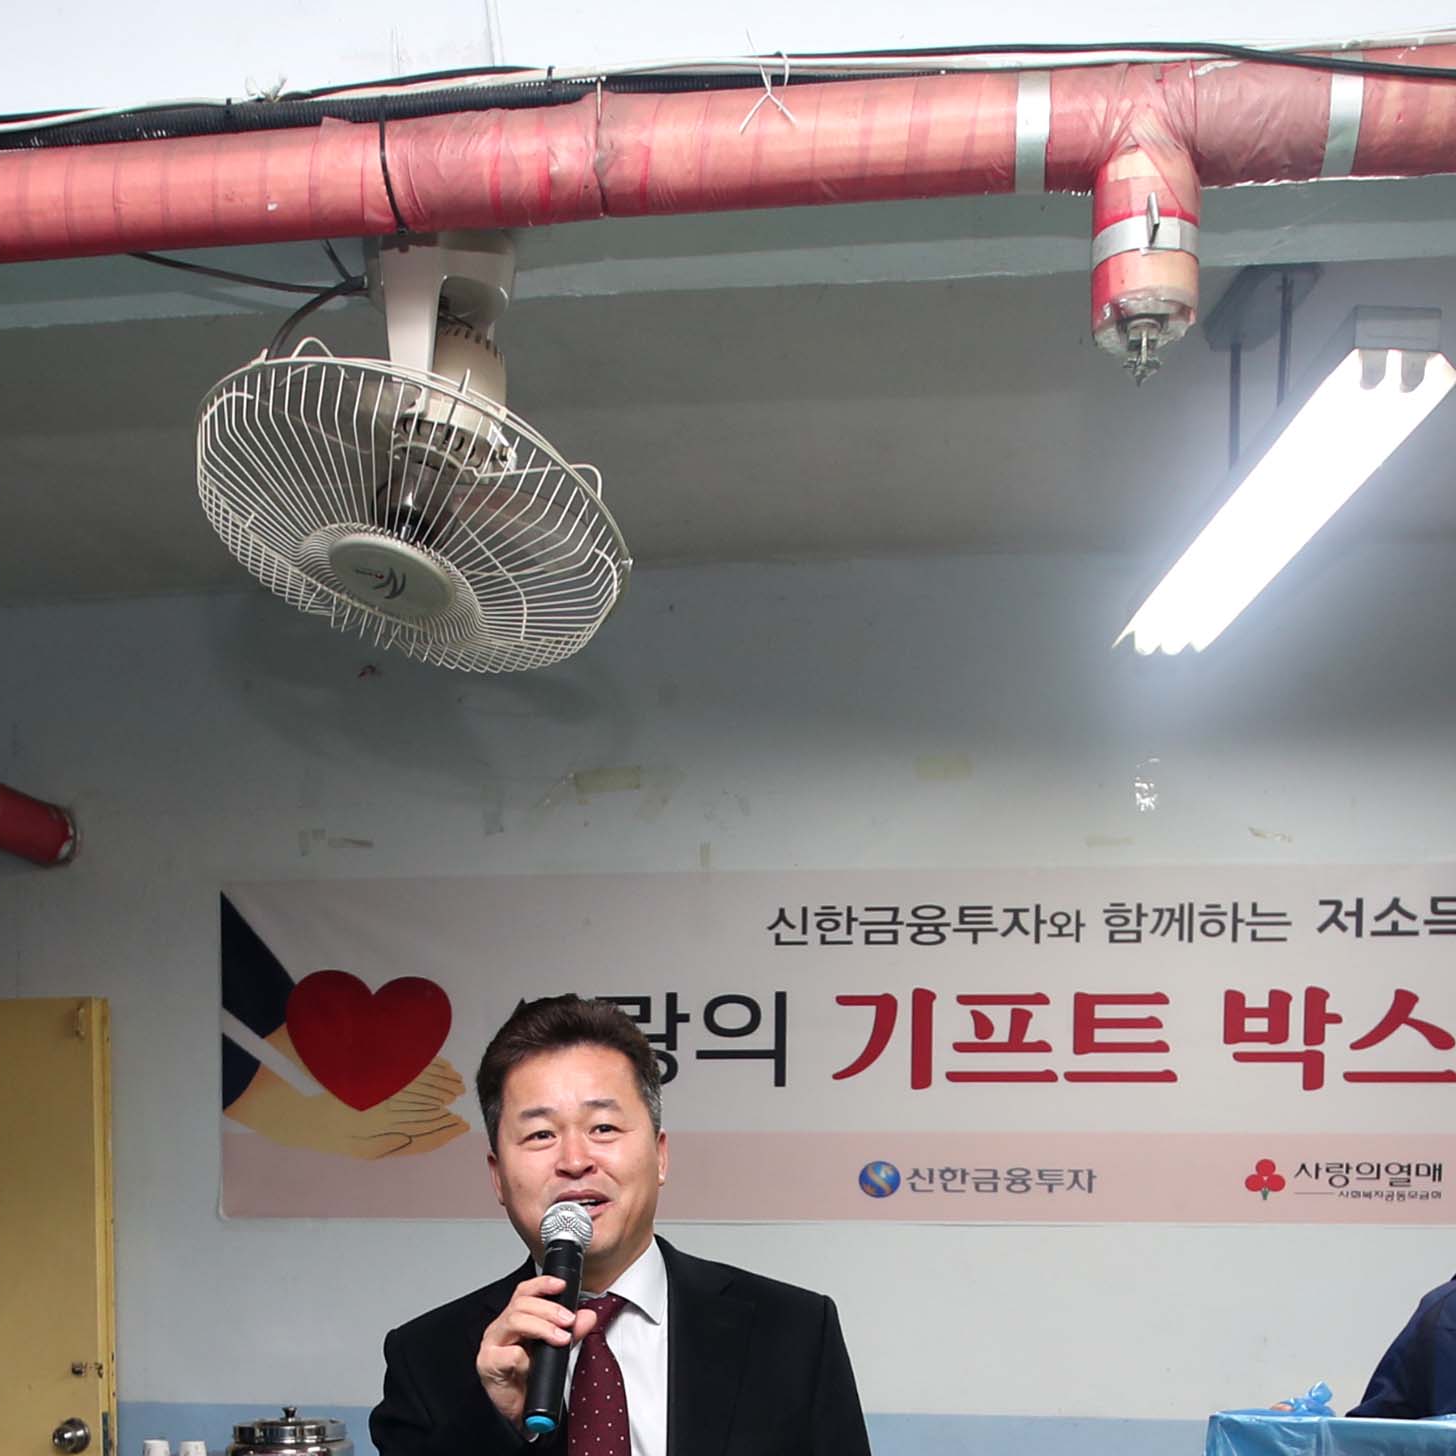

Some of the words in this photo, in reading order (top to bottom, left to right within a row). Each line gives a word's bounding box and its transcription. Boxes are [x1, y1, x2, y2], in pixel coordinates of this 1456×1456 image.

[767, 903, 1086, 946] 신한금융투자와
[1102, 901, 1293, 944] 함께하는
[595, 991, 787, 1087] 랑의
[831, 987, 1179, 1091] 기프트
[906, 1166, 1097, 1195] 신한금융투자
[1293, 1162, 1443, 1189] 사랑의열매
